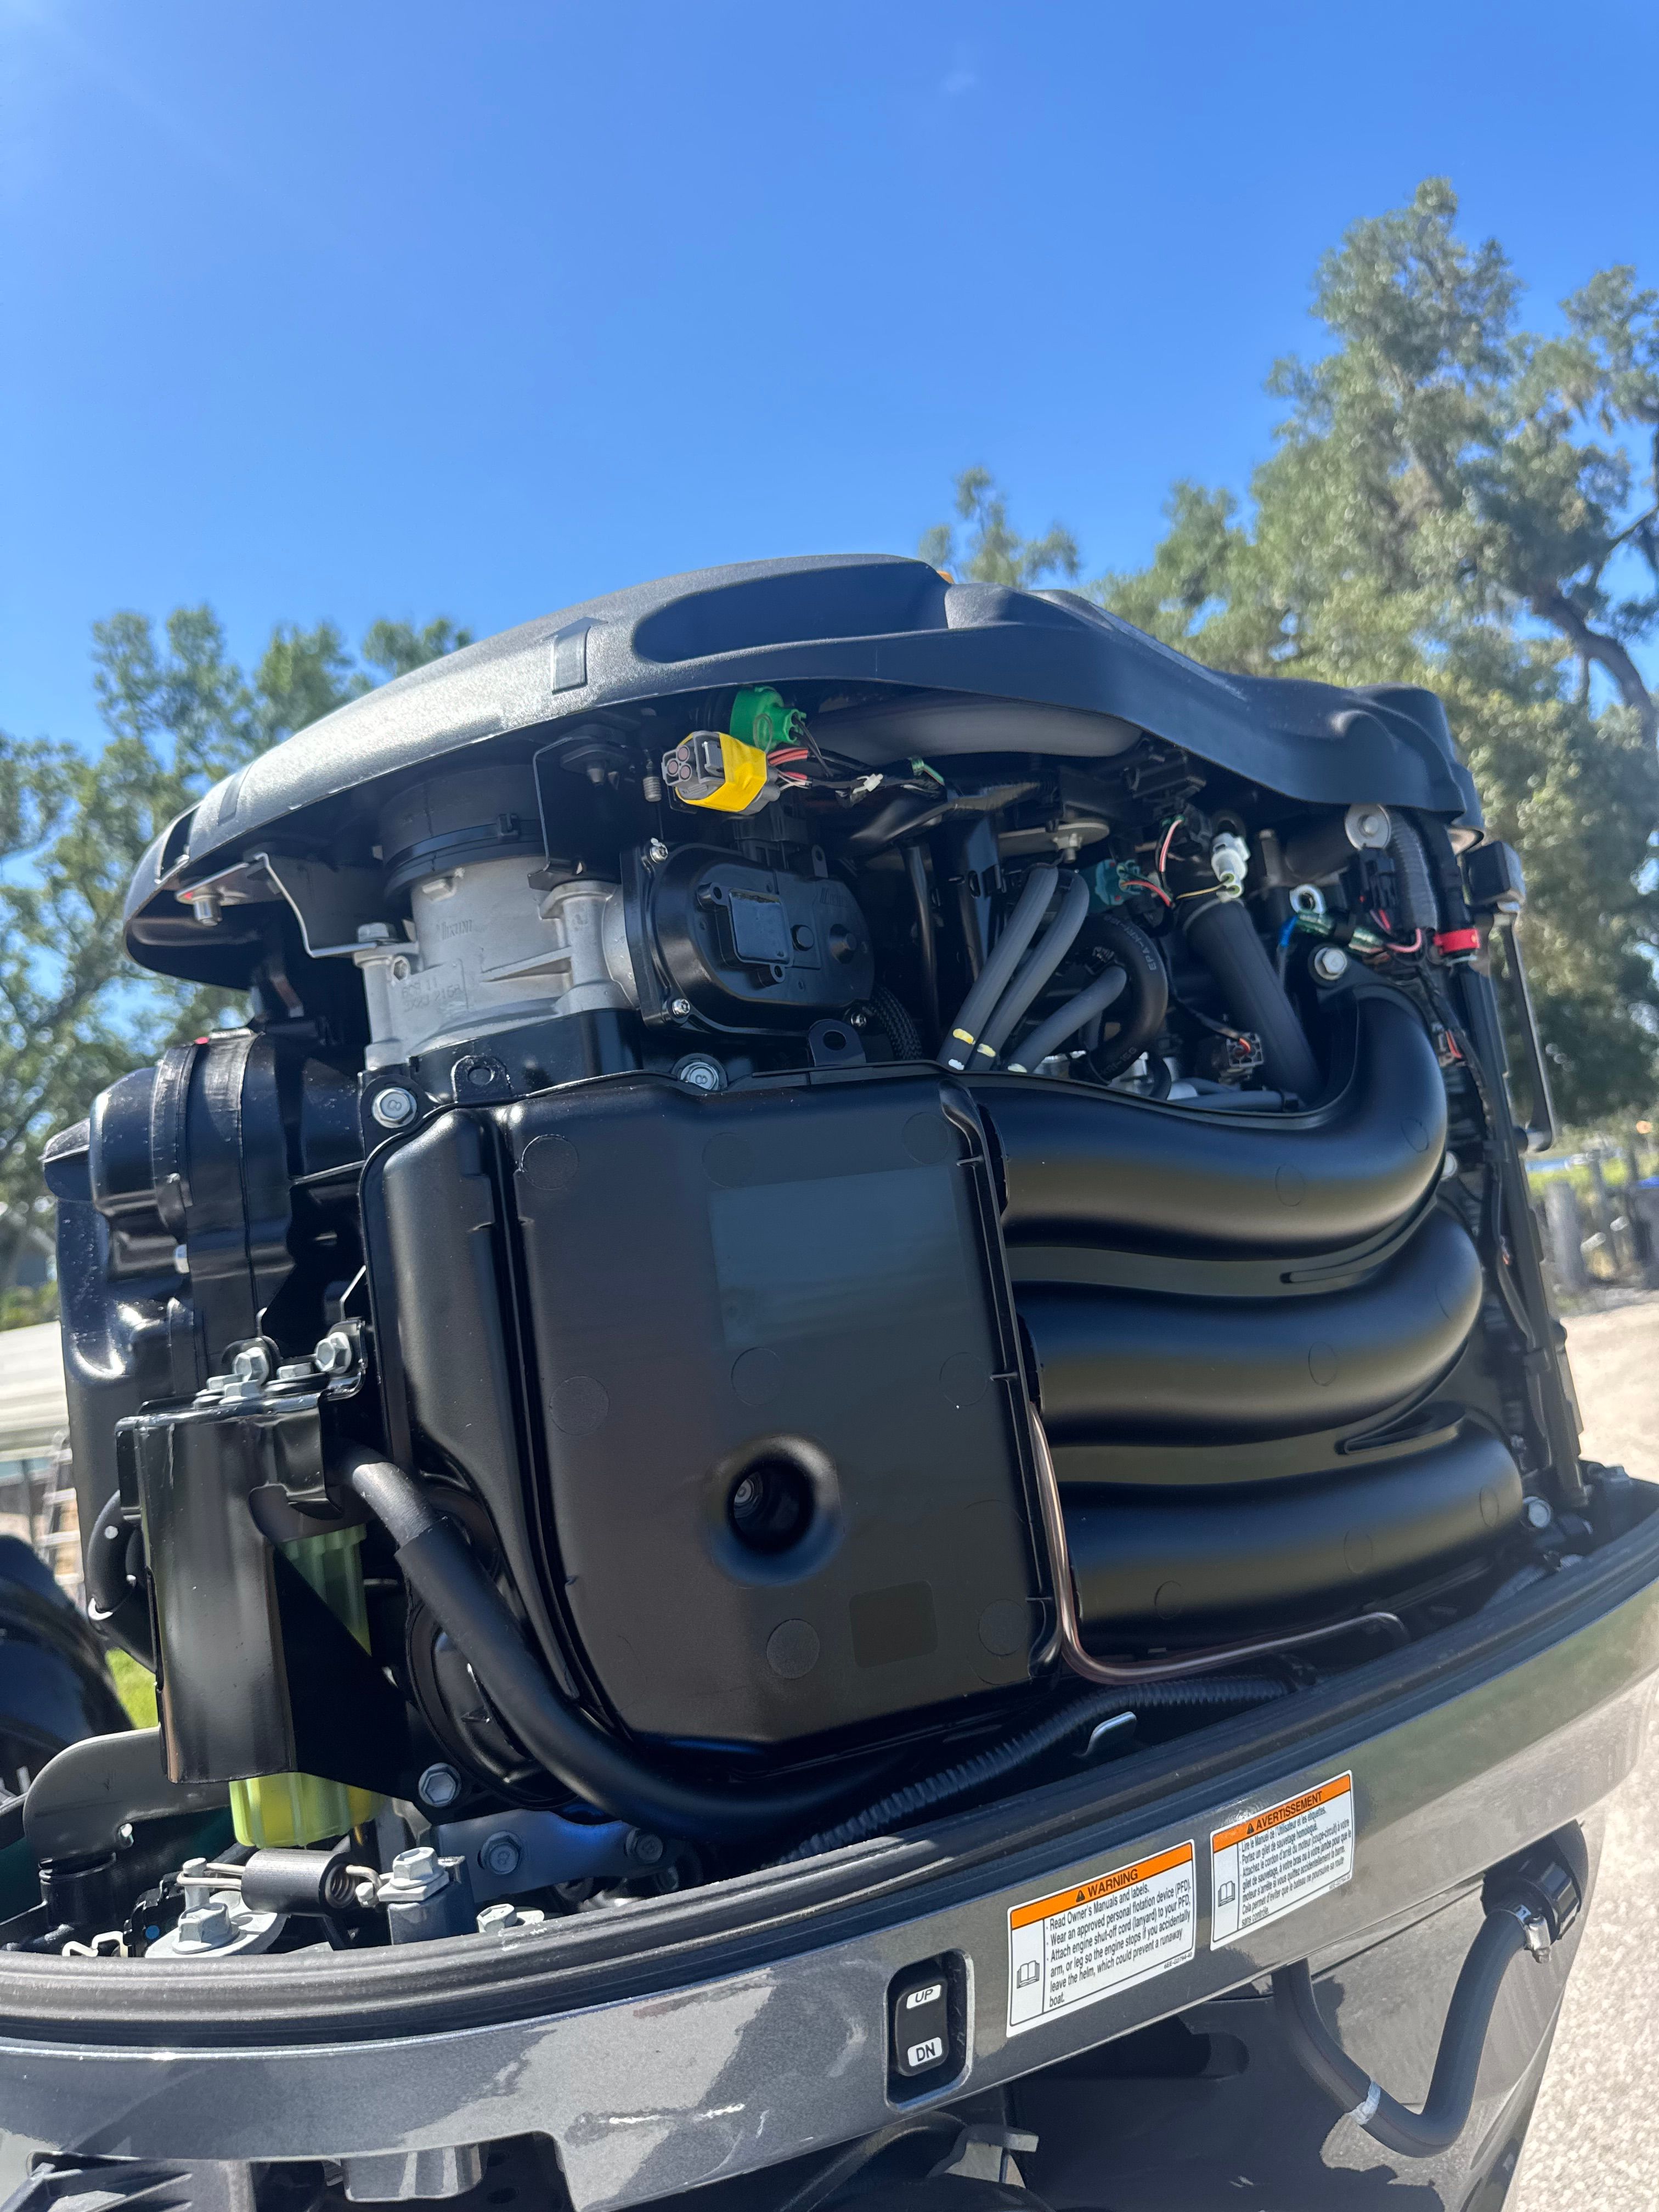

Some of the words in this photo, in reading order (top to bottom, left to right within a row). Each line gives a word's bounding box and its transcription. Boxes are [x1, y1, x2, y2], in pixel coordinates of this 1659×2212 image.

[1242, 1840, 1250, 1852] Lire
[1250, 1839, 1254, 1848] le
[1255, 1830, 1269, 1845] Manuel
[1269, 1829, 1274, 1839] de
[1297, 1818, 1301, 1826] et
[1256, 1791, 1322, 1831] AVERTISSEMENT
[1242, 1851, 1255, 1864] Portez
[1256, 1850, 1261, 1859] un
[1262, 1845, 1270, 1858] gilet
[1271, 1842, 1276, 1851] de
[1277, 1832, 1296, 1848] sauvetage
[1243, 1862, 1260, 1876] Attachez
[1261, 1859, 1264, 1869] le
[1265, 1853, 1278, 1866] cordon
[1293, 1843, 1297, 1854] du
[1298, 1837, 1311, 1850] moteur
[1338, 1821, 1340, 1831] à
[1340, 1819, 1349, 1829] votre
[1243, 1877, 1251, 1892] gilet
[1252, 1875, 1257, 1886] de
[1279, 1862, 1282, 1872] à
[1283, 1859, 1292, 1870] votre
[1293, 1854, 1301, 1866] bras
[1307, 1848, 1310, 1858] à
[1311, 1846, 1320, 1857] votre
[1321, 1839, 1331, 1853] jambe
[1332, 1836, 1340, 1847] pour
[1348, 1829, 1351, 1838] le
[1088, 1869, 1138, 1897] WARNING
[1242, 1903, 1251, 1915] Cela
[1252, 1897, 1266, 1912] permet
[1289, 1881, 1293, 1891] le
[1294, 1876, 1306, 1889] bateau
[1312, 1864, 1329, 1882] poursuive
[1330, 1862, 1334, 1870] sa
[1335, 1857, 1344, 1867] route
[1243, 1889, 1256, 1903] moteur
[1273, 1878, 1277, 1887] si
[1277, 1875, 1286, 1886] vous
[1287, 1867, 1300, 1880] quittez
[1301, 1852, 1330, 1874] accidentellement
[1049, 1916, 1065, 1931] Read
[1067, 1905, 1092, 1925] Owner's
[1093, 1897, 1118, 1914] Manuals
[1119, 1891, 1130, 1904] and
[1131, 1882, 1149, 1899] labels.
[1051, 1931, 1066, 1946] Wear
[1068, 1929, 1075, 1940] an
[1077, 1915, 1105, 1939] approved
[1107, 1903, 1131, 1925] personal
[1133, 1896, 1155, 1912] flotation
[1156, 1888, 1174, 1903] device
[1175, 1878, 1191, 1894] (PFD).
[1051, 1947, 1071, 1962] Attach
[1072, 1937, 1093, 1954] engine
[1094, 1924, 1116, 1944] shut-off
[1118, 1922, 1131, 1934] cord
[1133, 1909, 1157, 1931] (lanyard)
[1158, 1909, 1163, 1917] to
[1165, 1901, 1177, 1915] your
[1178, 1893, 1190, 1908] PFD,
[1242, 1916, 1251, 1926] sans
[1050, 1978, 1066, 1993] leave
[1068, 1973, 1077, 1985] the
[1079, 1966, 1096, 1980] helm,
[1097, 1958, 1114, 1973] which
[1115, 1950, 1131, 1965] could
[1133, 1940, 1154, 1961] prevent
[1160, 1928, 1183, 1946] runaway
[1051, 1965, 1064, 1978] arm,
[1065, 1961, 1073, 1971] or
[1074, 1956, 1083, 1969] leg
[1085, 1952, 1092, 1963] so
[1093, 1947, 1103, 1960] the
[1104, 1939, 1124, 1955] engine
[1125, 1932, 1141, 1946] stops
[1142, 1927, 1147, 1940] if
[1147, 1924, 1158, 1940] you
[1159, 1910, 1190, 1933] accidentally
[915, 1988, 934, 2003] UP
[1049, 1992, 1065, 2007] boat.
[916, 2041, 936, 2062] DN
